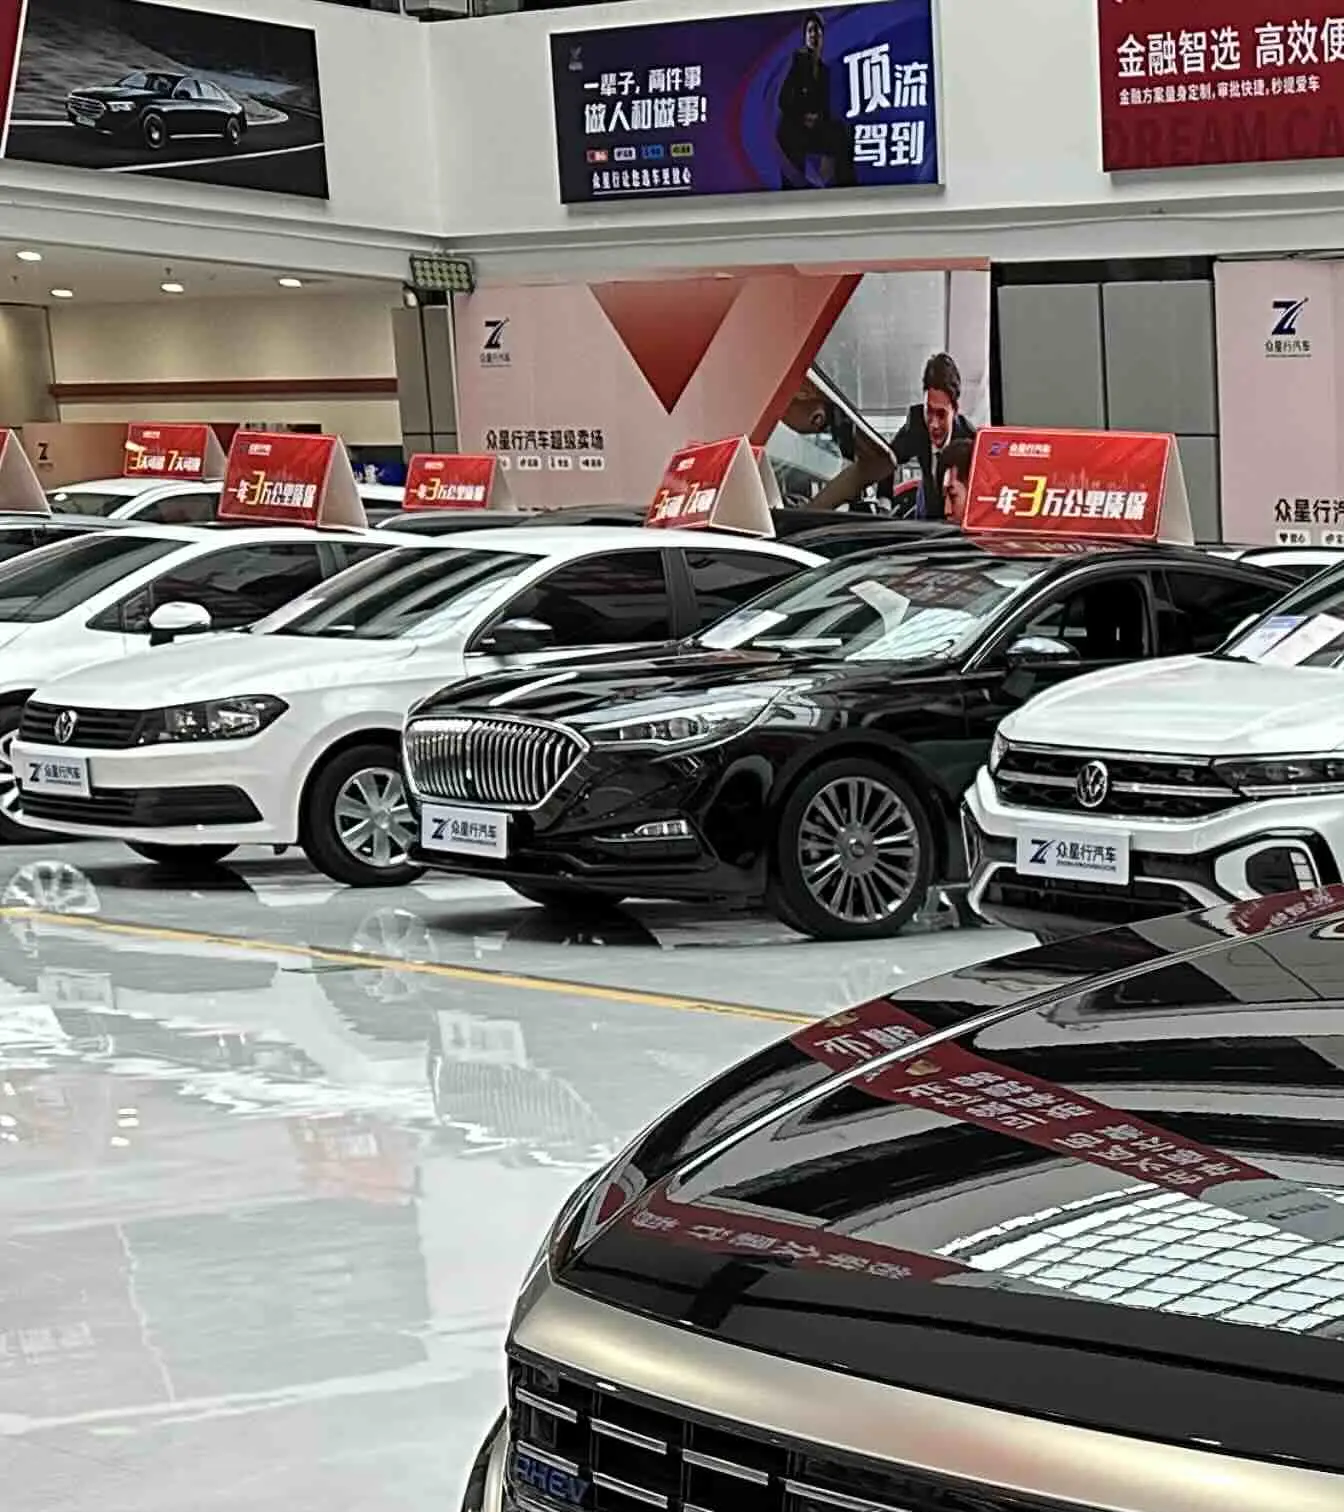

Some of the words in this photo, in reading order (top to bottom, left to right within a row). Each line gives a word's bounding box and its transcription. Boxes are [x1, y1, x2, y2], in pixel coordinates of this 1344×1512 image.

[1117, 25, 1240, 77] 金融智选
[844, 43, 929, 118] 顶流
[853, 121, 925, 168] 驾到
[977, 475, 1148, 520] 一年3万公里质保
[1056, 841, 1116, 863] 众星行汽车
